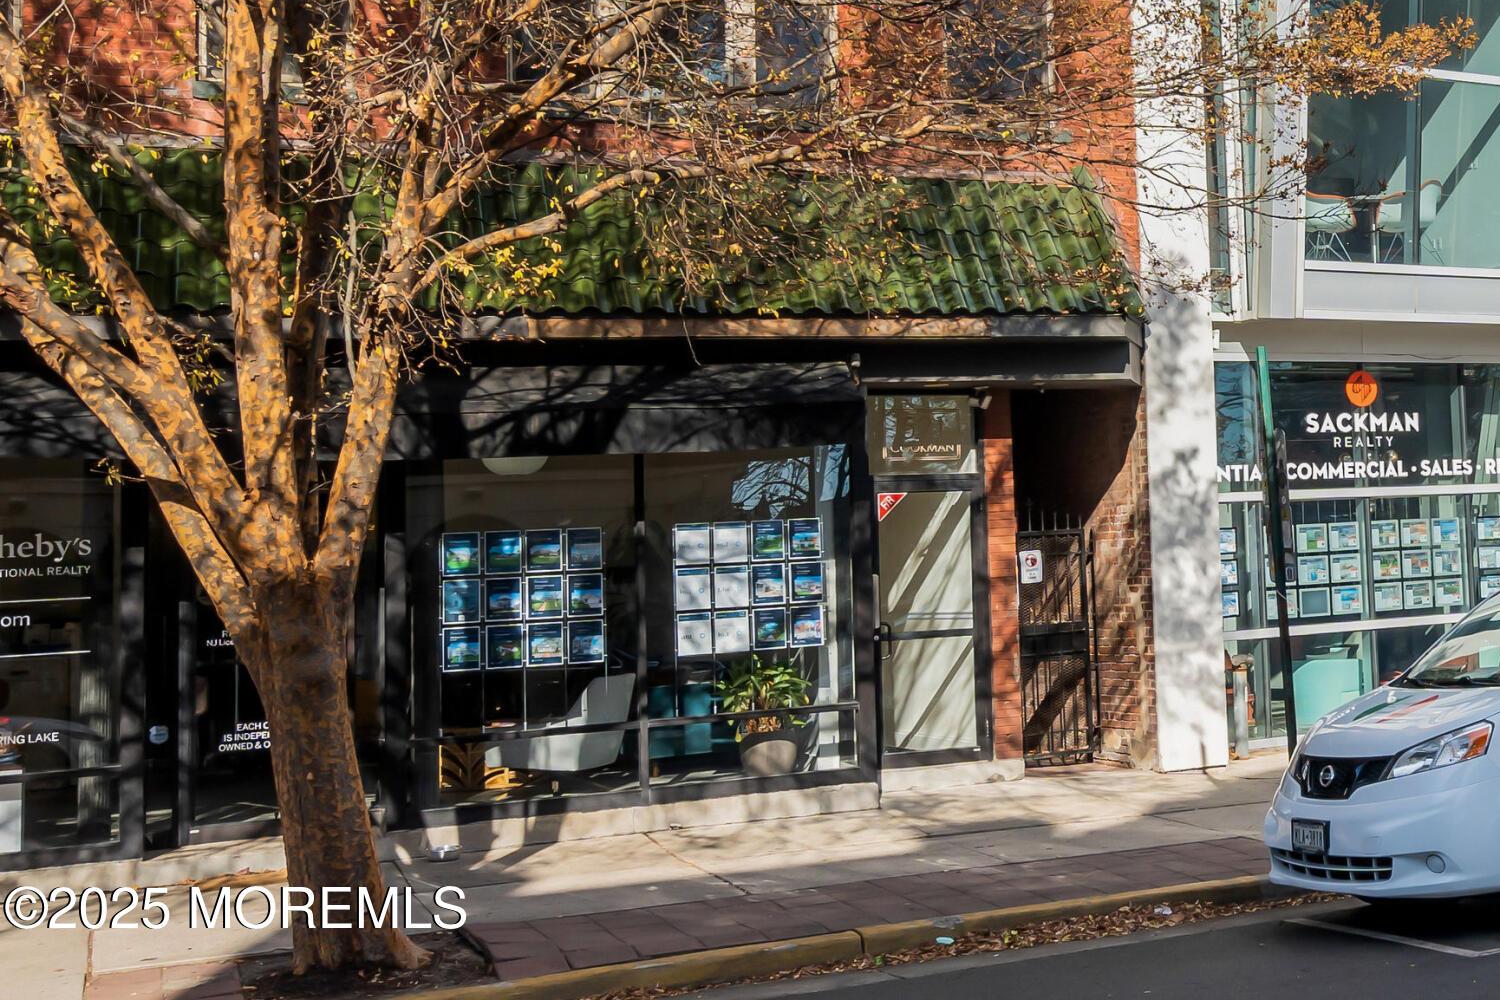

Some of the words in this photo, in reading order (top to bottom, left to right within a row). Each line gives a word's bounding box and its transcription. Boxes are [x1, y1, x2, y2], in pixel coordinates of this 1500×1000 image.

[1305, 412, 1420, 433] SACKMAN
[1333, 436, 1394, 448] REALTY
[1217, 464, 1263, 483] NTIA
[1286, 460, 1408, 480] COMMERCIAL
[1420, 459, 1473, 476] SALES
[47, 565, 91, 576] REALTY
[0, 614, 31, 628] om
[236, 722, 261, 732] EACH
[28, 732, 60, 744] LAKE
[224, 734, 232, 742] IS
[218, 742, 253, 752] OWNED
